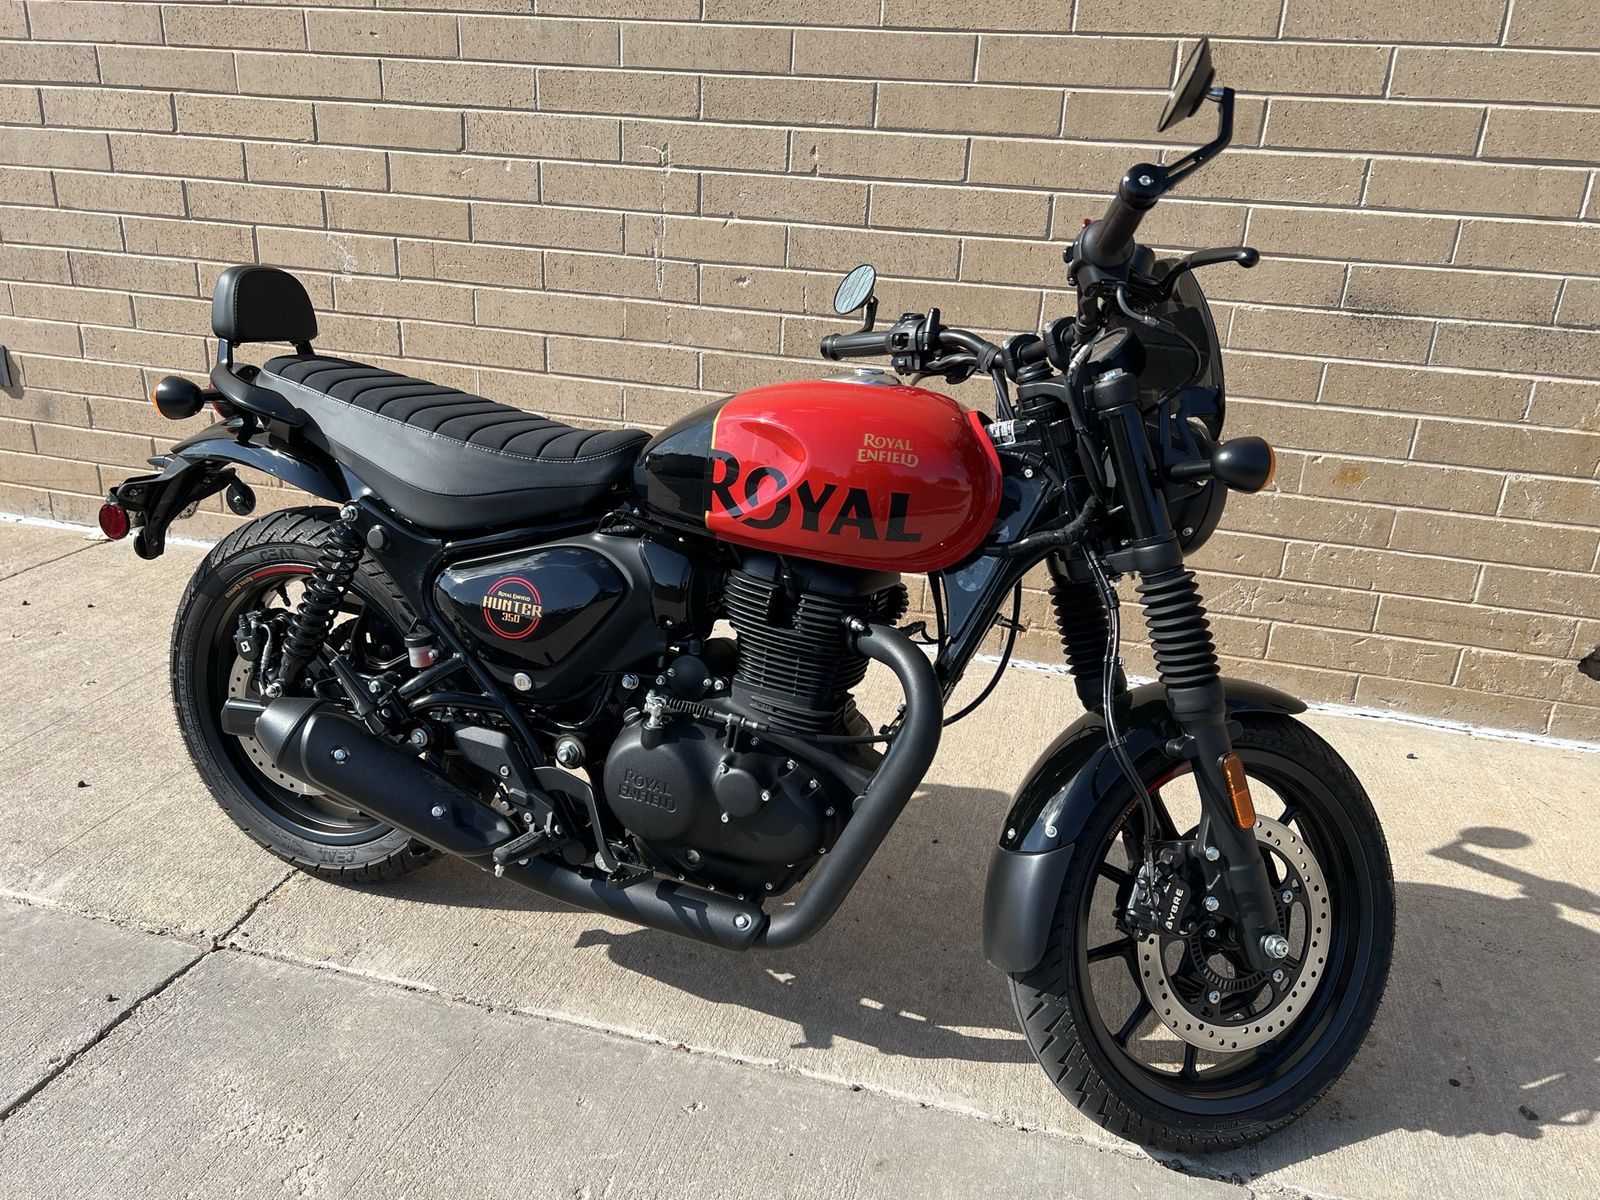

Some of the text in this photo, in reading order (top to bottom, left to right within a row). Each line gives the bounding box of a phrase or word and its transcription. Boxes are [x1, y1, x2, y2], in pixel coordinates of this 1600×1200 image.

[863, 432, 913, 451] ROYAL
[857, 448, 919, 468] ENFIELD
[705, 448, 923, 543] ROYAL
[259, 548, 299, 562] CEAT
[482, 595, 542, 618] HUNTER
[501, 611, 520, 624] 350
[624, 768, 672, 797] ROYAL
[618, 783, 679, 814] ENFIELD
[1165, 888, 1184, 930] BYBRE
